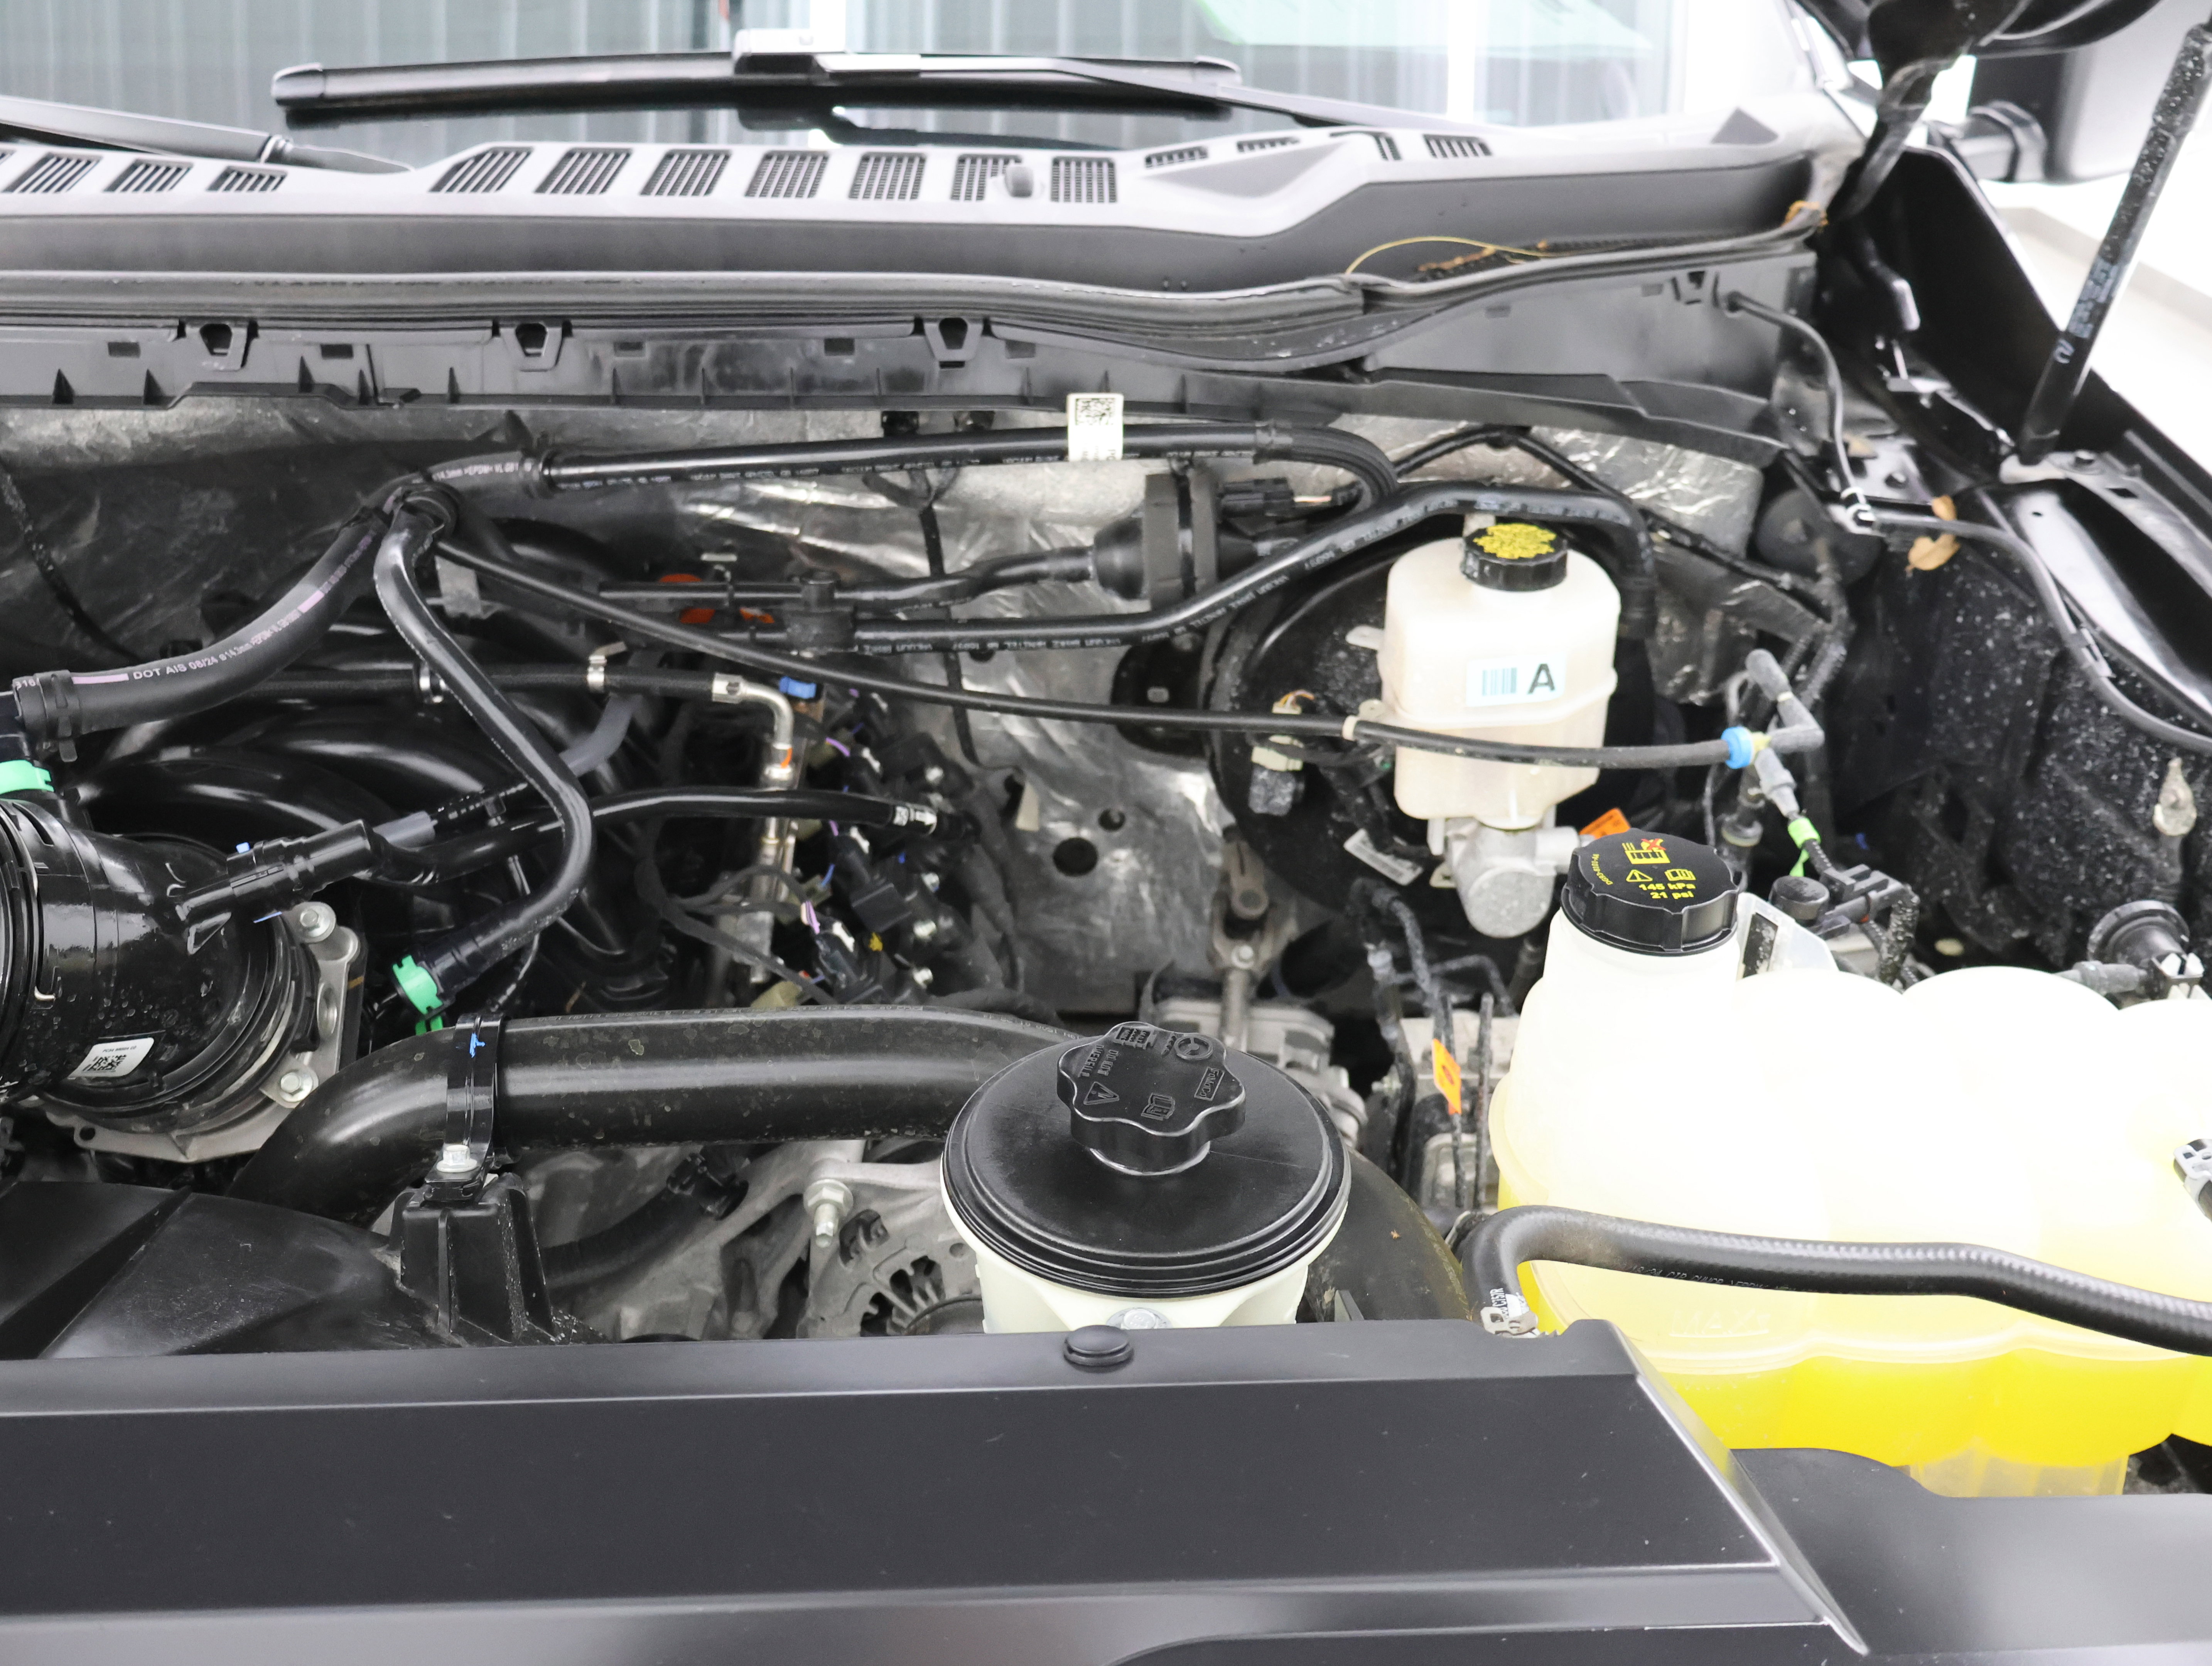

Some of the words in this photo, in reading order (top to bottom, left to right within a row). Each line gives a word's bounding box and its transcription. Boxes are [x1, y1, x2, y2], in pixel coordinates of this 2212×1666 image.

[133, 668, 161, 680] DOT
[1527, 663, 1556, 695] A
[1672, 890, 1694, 900] psi
[1200, 1068, 1220, 1096] FoMoCo
